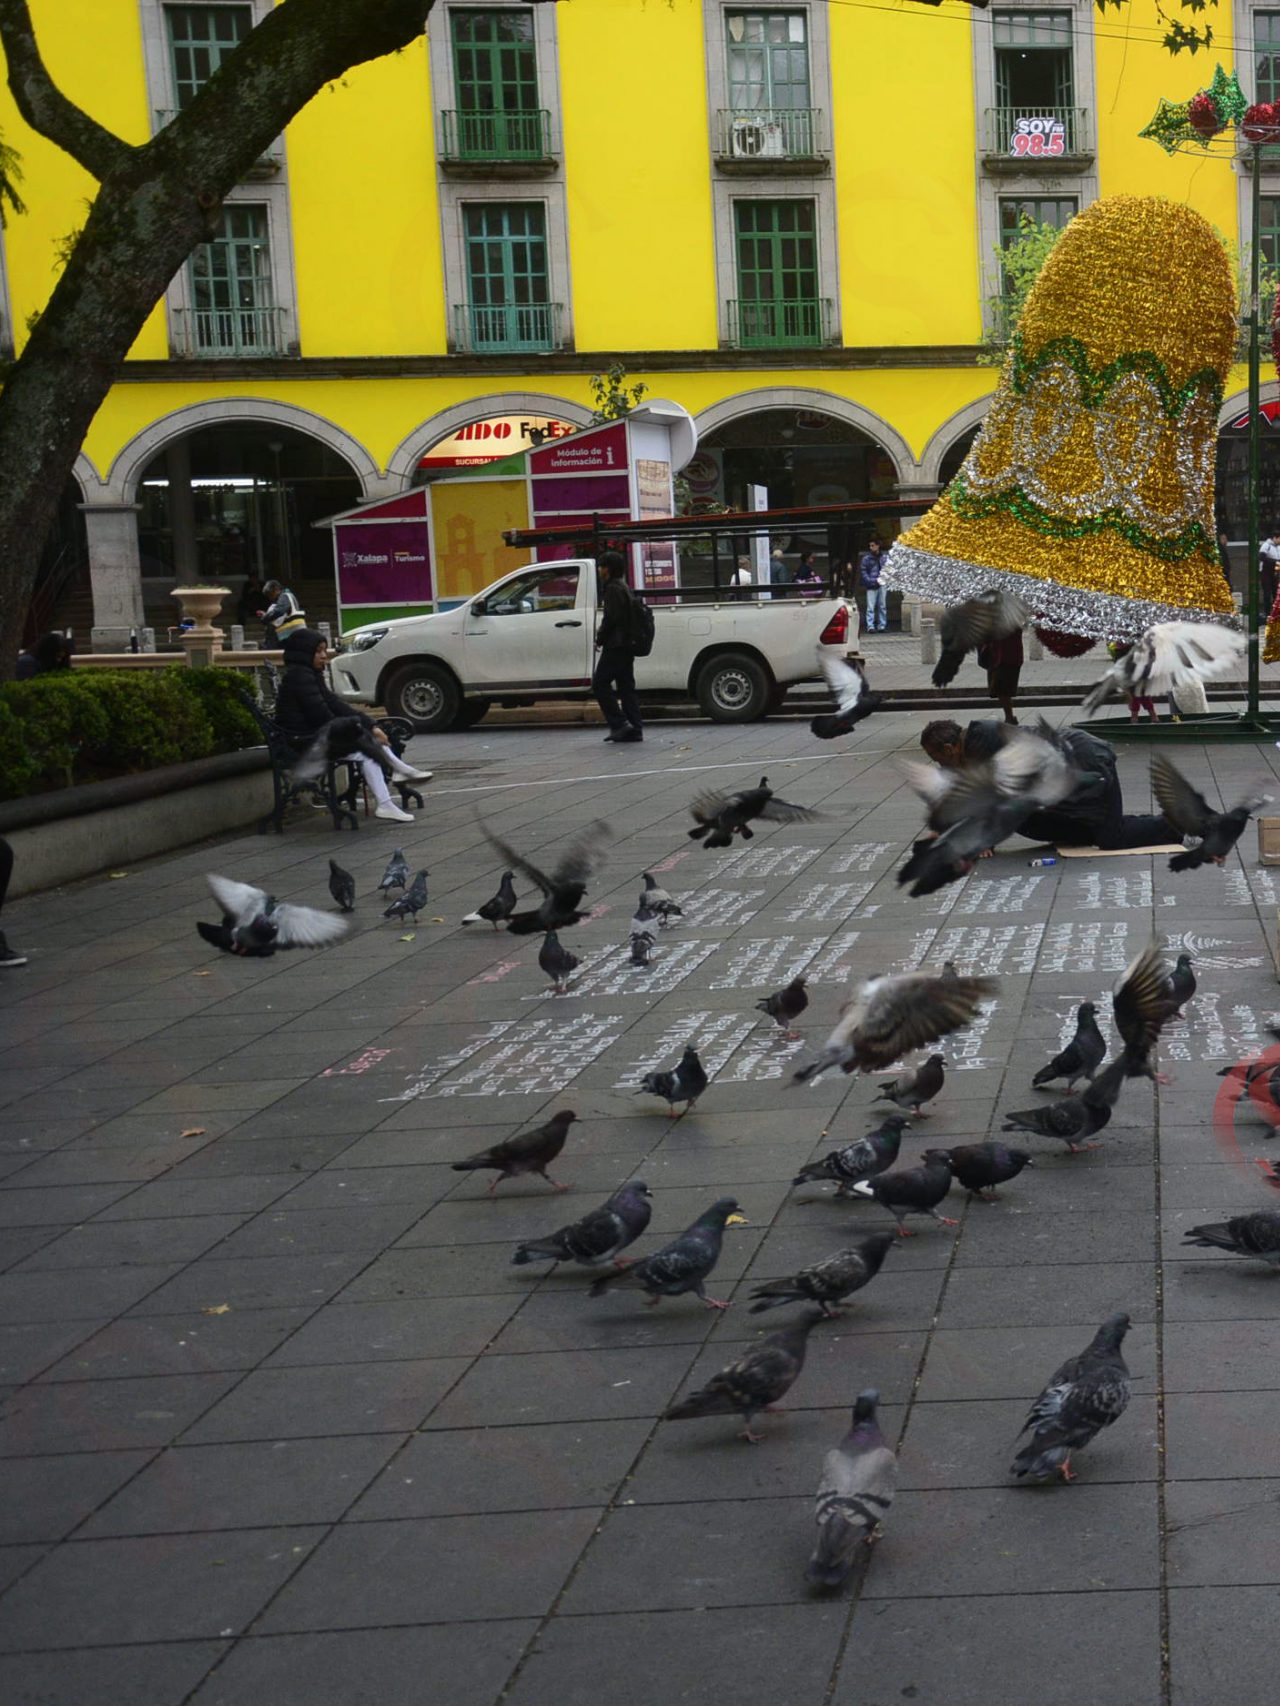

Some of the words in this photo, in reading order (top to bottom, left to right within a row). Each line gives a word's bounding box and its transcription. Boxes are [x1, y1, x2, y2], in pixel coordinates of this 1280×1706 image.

[1018, 120, 1054, 133] SOY
[1013, 133, 1065, 156] 98.5
[557, 448, 589, 457] Módulo
[551, 457, 602, 467] información
[357, 554, 388, 564] Xalapa
